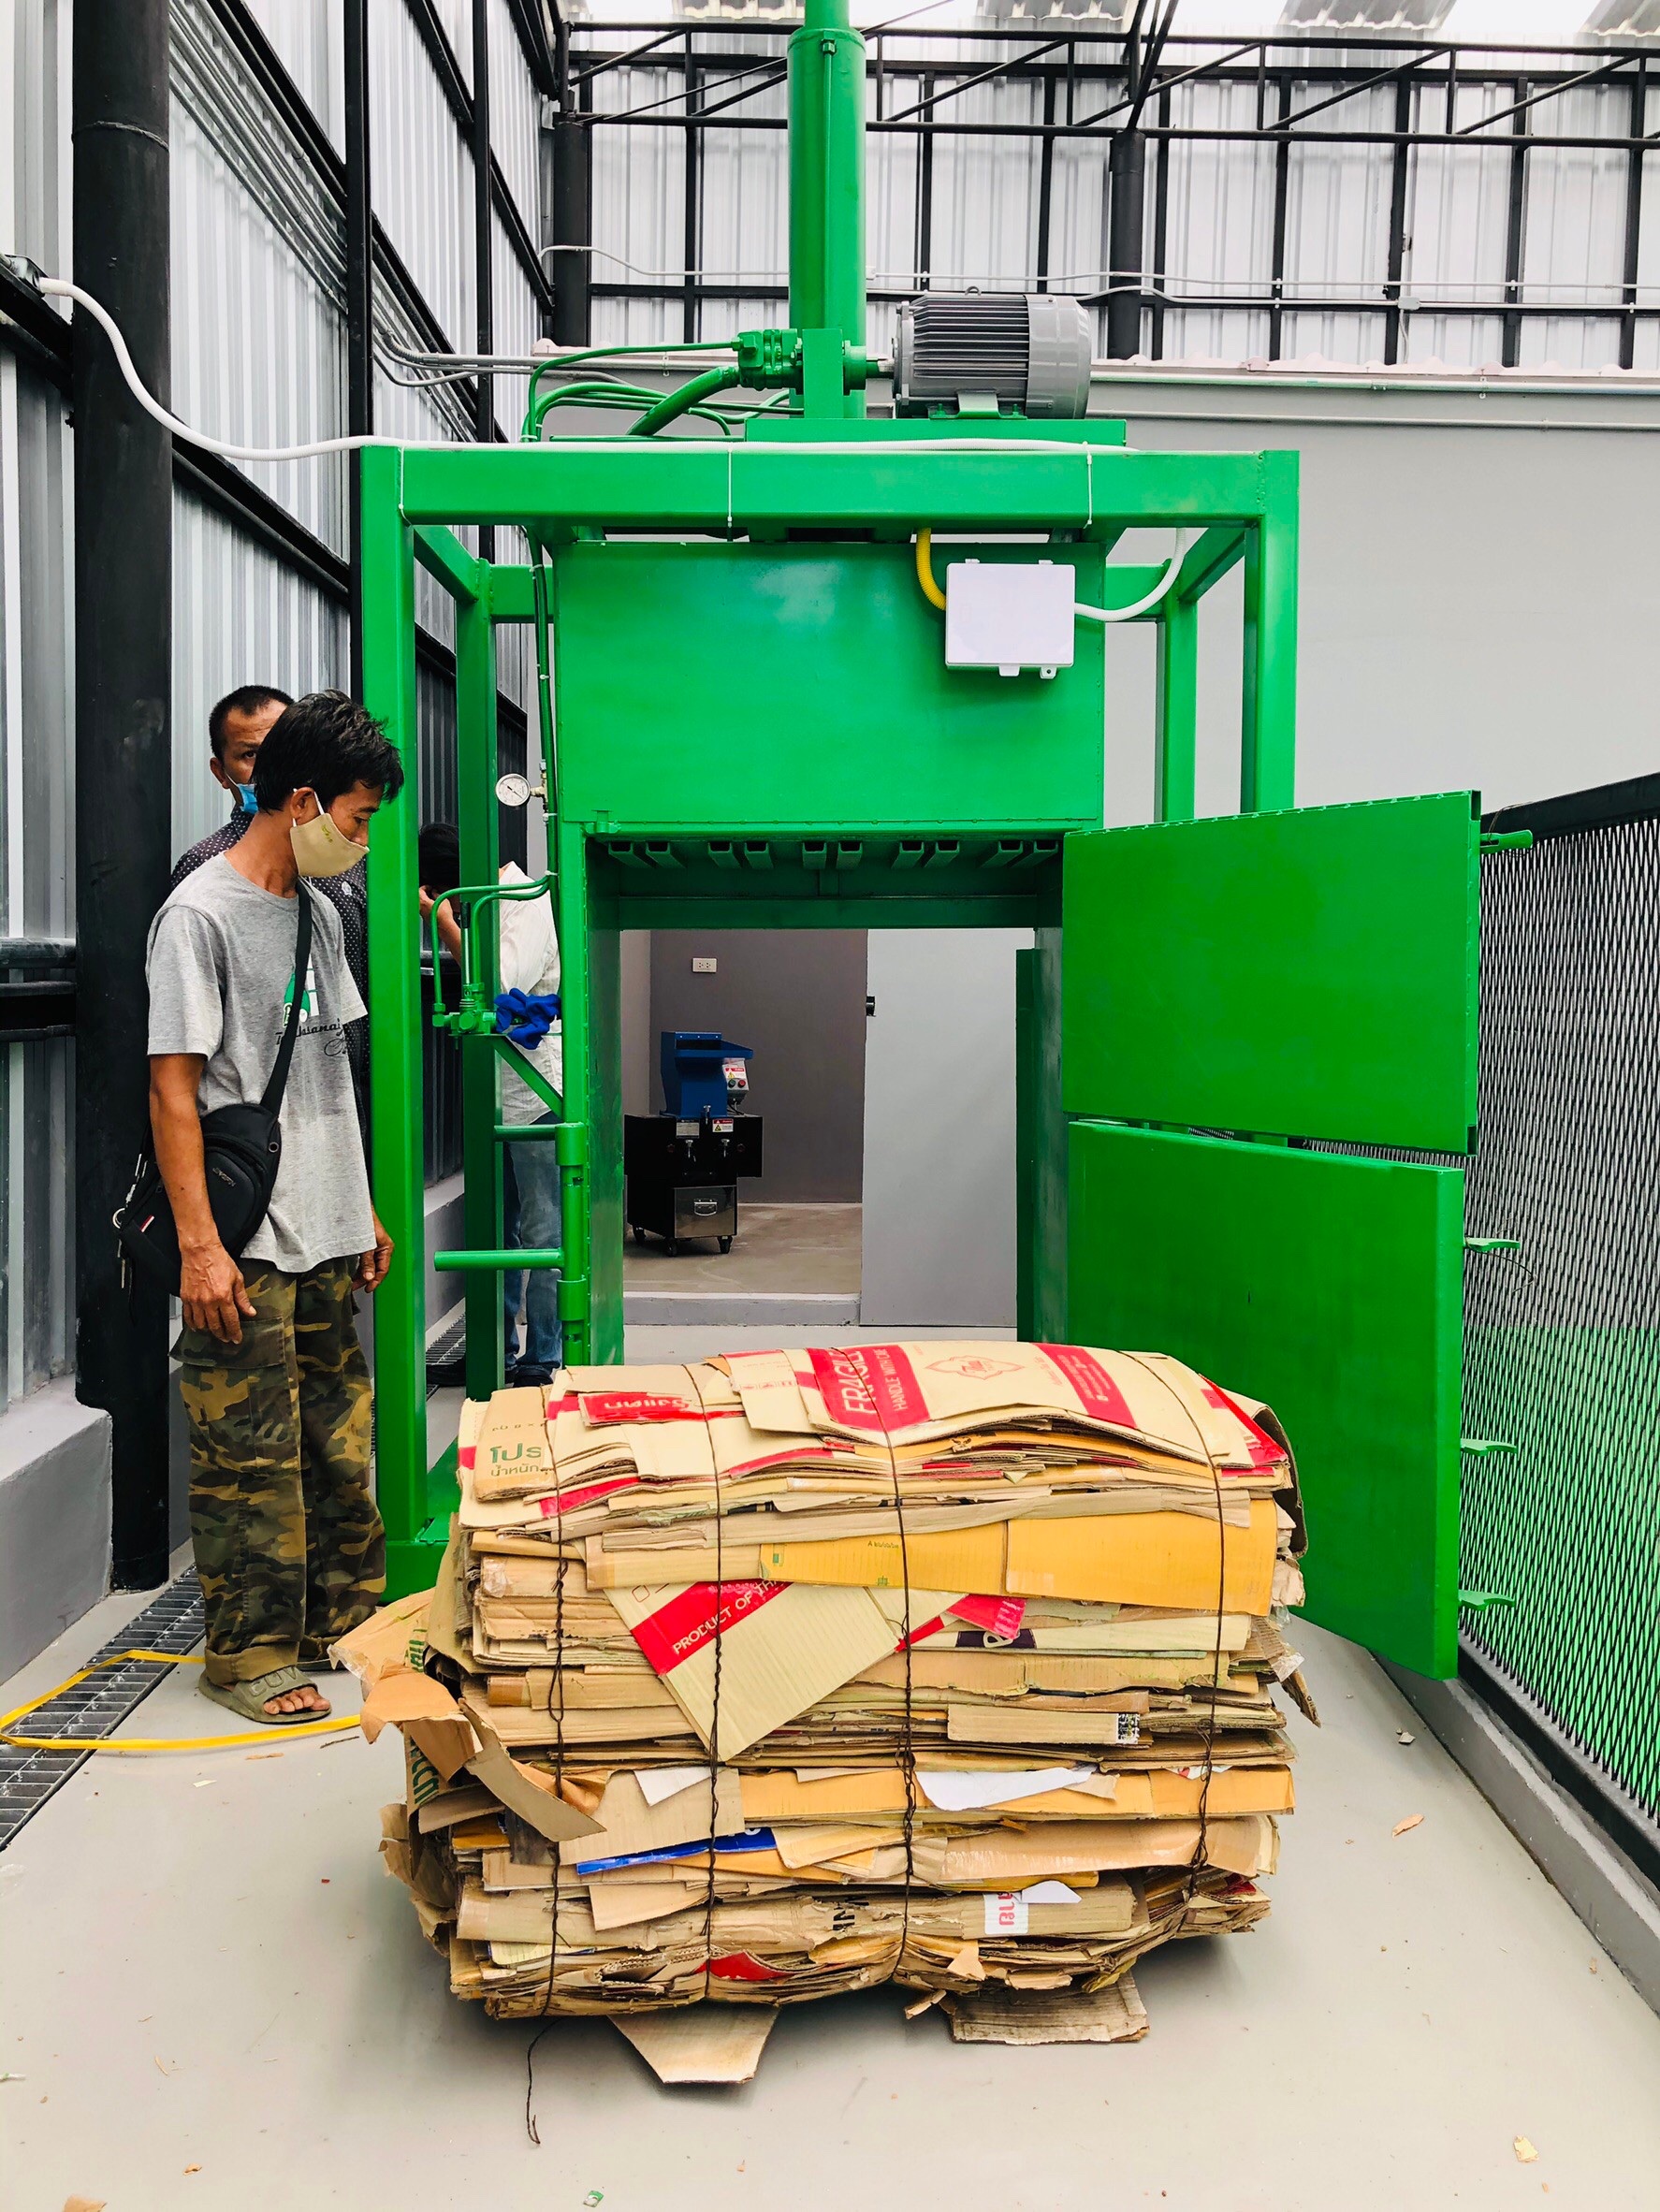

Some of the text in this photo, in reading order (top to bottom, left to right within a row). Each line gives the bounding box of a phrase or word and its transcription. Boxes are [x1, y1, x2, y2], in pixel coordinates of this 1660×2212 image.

[881, 1360, 896, 1376] WITH
[884, 1376, 908, 1411] HANDLE
[672, 1606, 732, 1655] PRODUCT
[735, 1591, 754, 1610] OF
